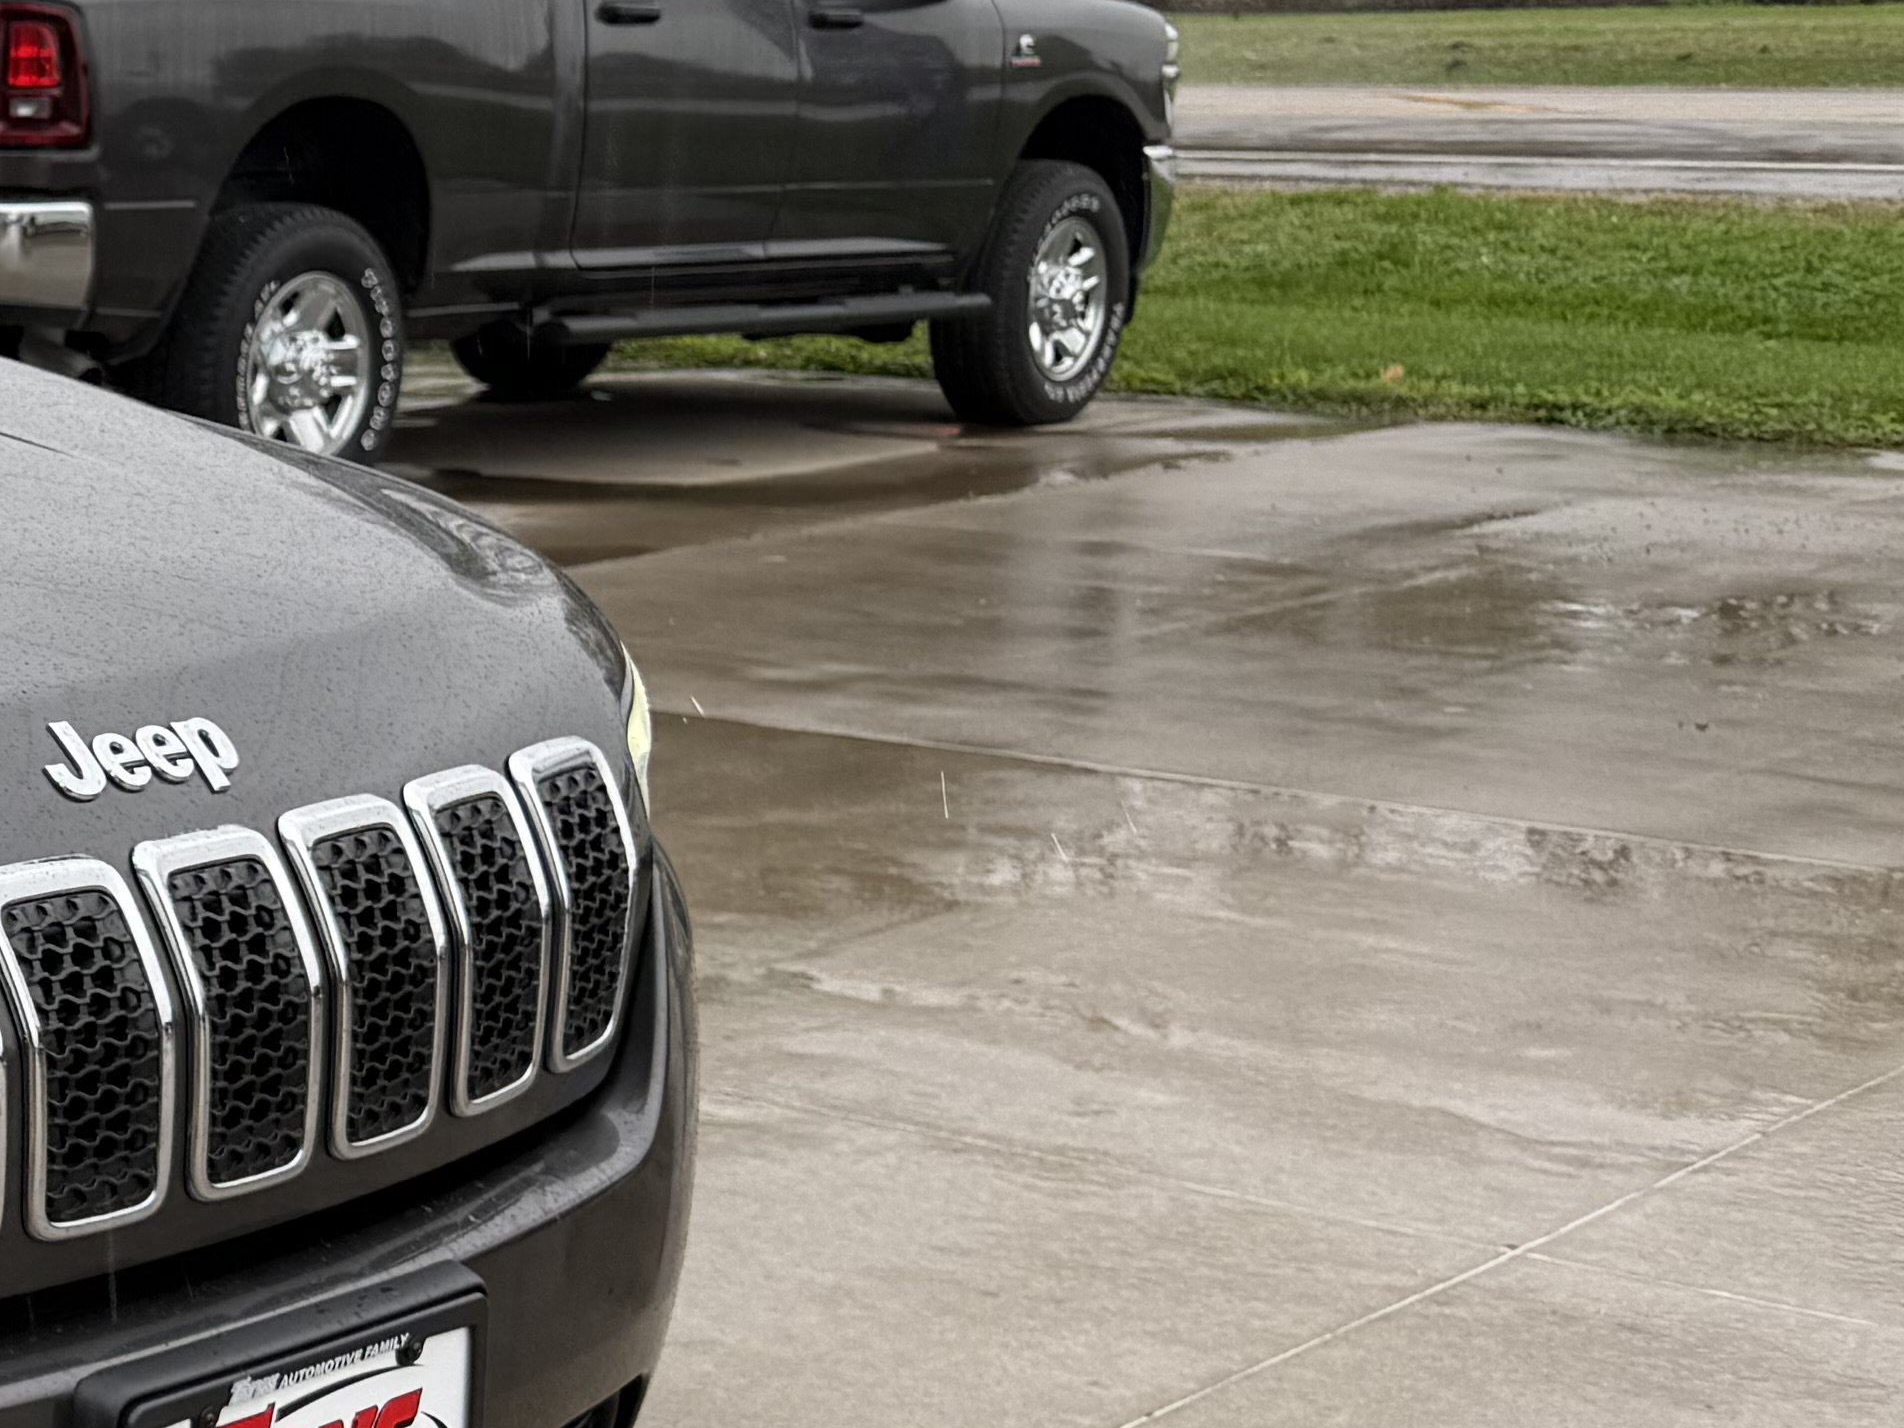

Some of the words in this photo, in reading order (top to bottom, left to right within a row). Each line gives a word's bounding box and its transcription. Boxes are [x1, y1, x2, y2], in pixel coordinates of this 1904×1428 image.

[43, 717, 240, 802] Jeep
[278, 1350, 361, 1390] AUTOMOTIVE
[364, 1332, 409, 1360] FAMILY
